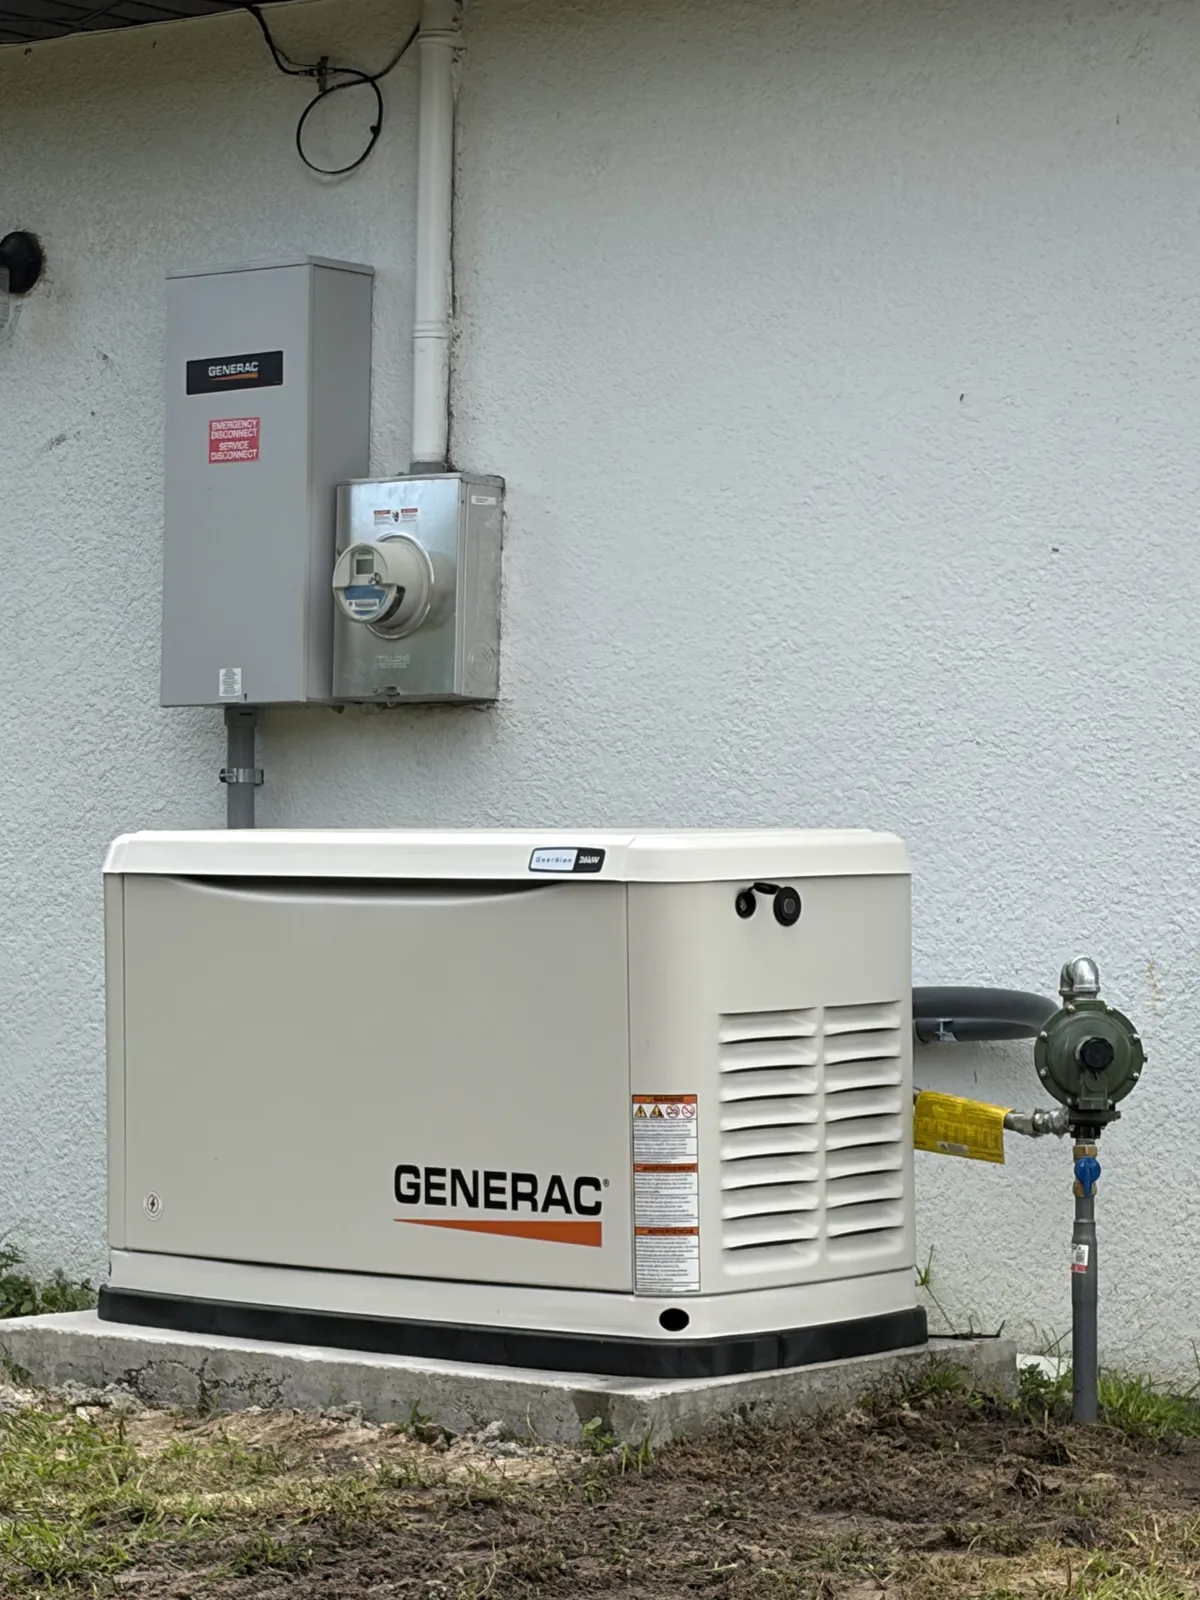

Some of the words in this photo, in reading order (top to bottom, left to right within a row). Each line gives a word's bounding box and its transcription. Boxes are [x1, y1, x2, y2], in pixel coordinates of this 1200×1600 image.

[208, 362, 259, 376] GENERAC
[211, 420, 258, 430] EMERGENCY
[211, 428, 257, 439] DISCONNECT
[218, 441, 250, 450] SERVICE
[211, 449, 257, 460] DISCONNECT
[535, 856, 573, 864] Guardian
[394, 1164, 603, 1216] GENERAC
